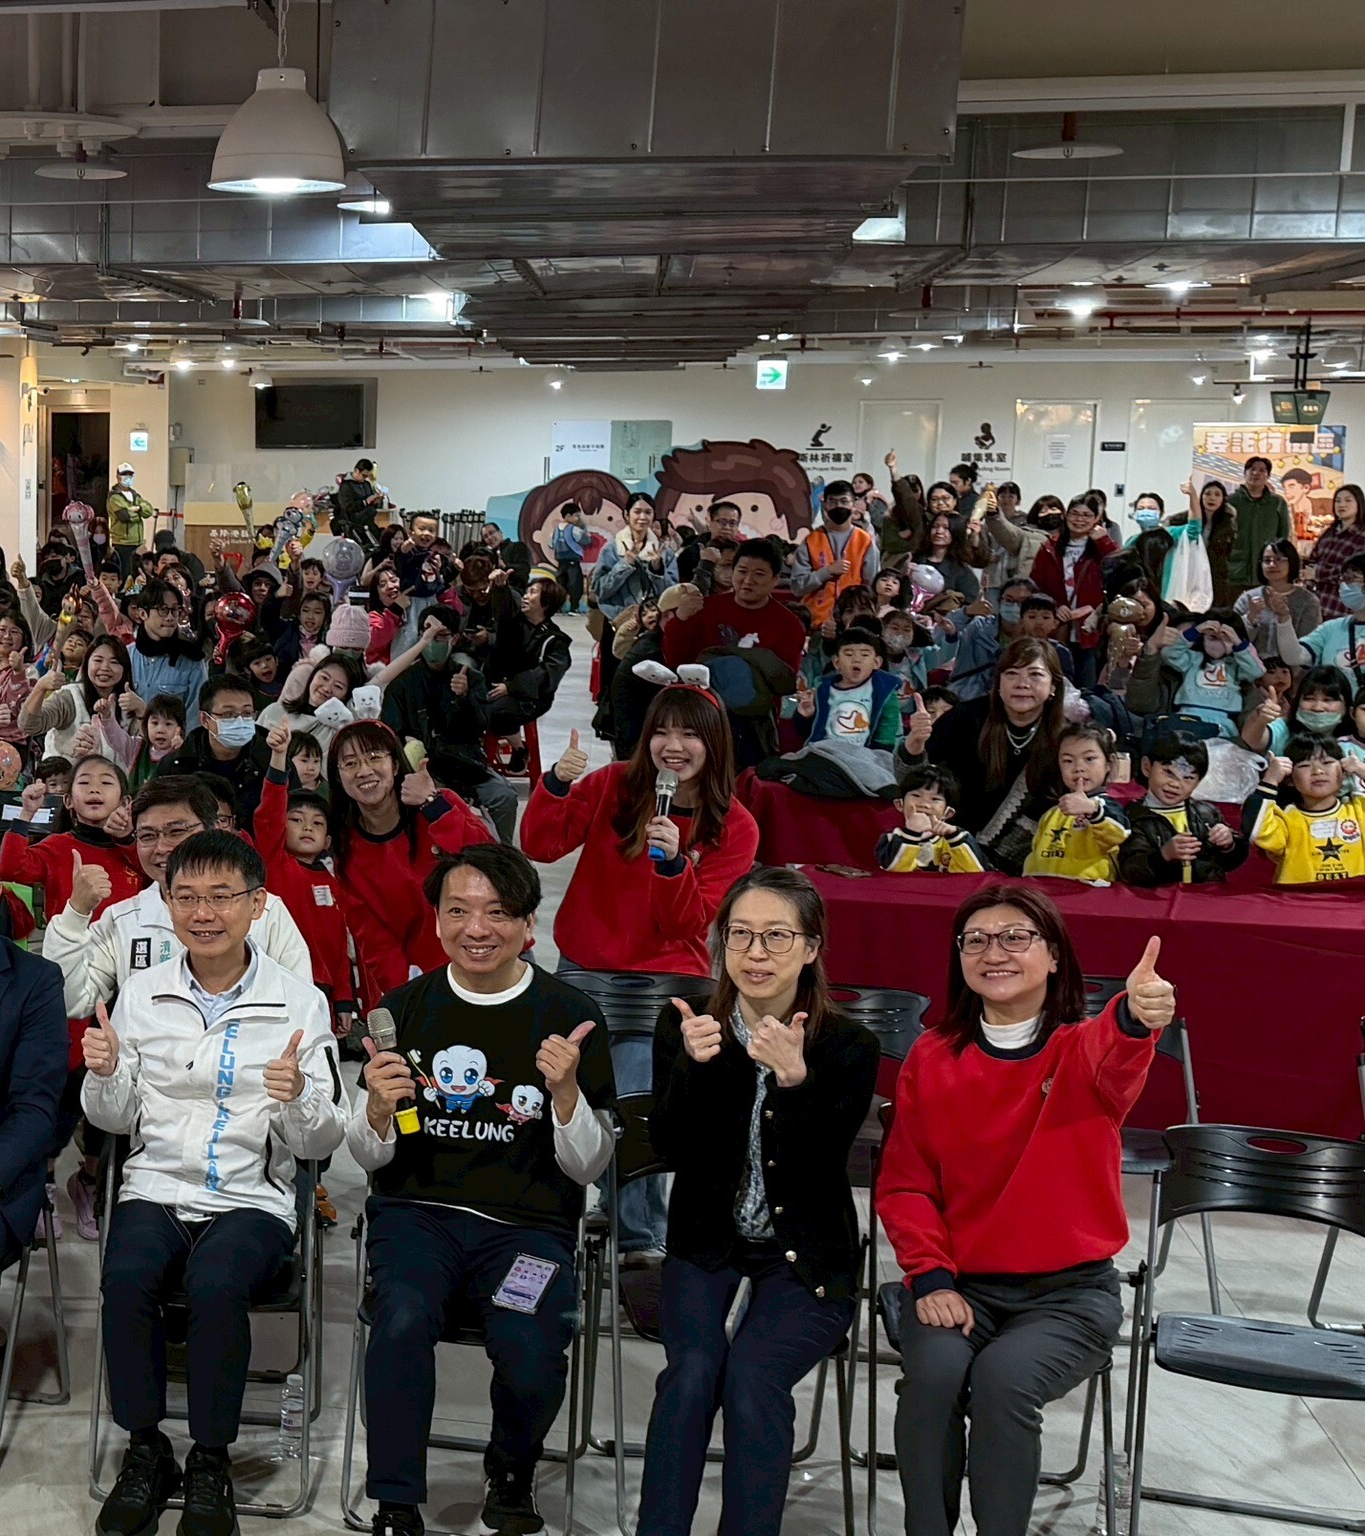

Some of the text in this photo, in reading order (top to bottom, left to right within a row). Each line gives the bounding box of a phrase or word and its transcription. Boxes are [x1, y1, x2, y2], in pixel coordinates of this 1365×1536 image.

[555, 444, 565, 452] 2F
[135, 941, 148, 967] 選區
[423, 1116, 515, 1143] KEELUNG
